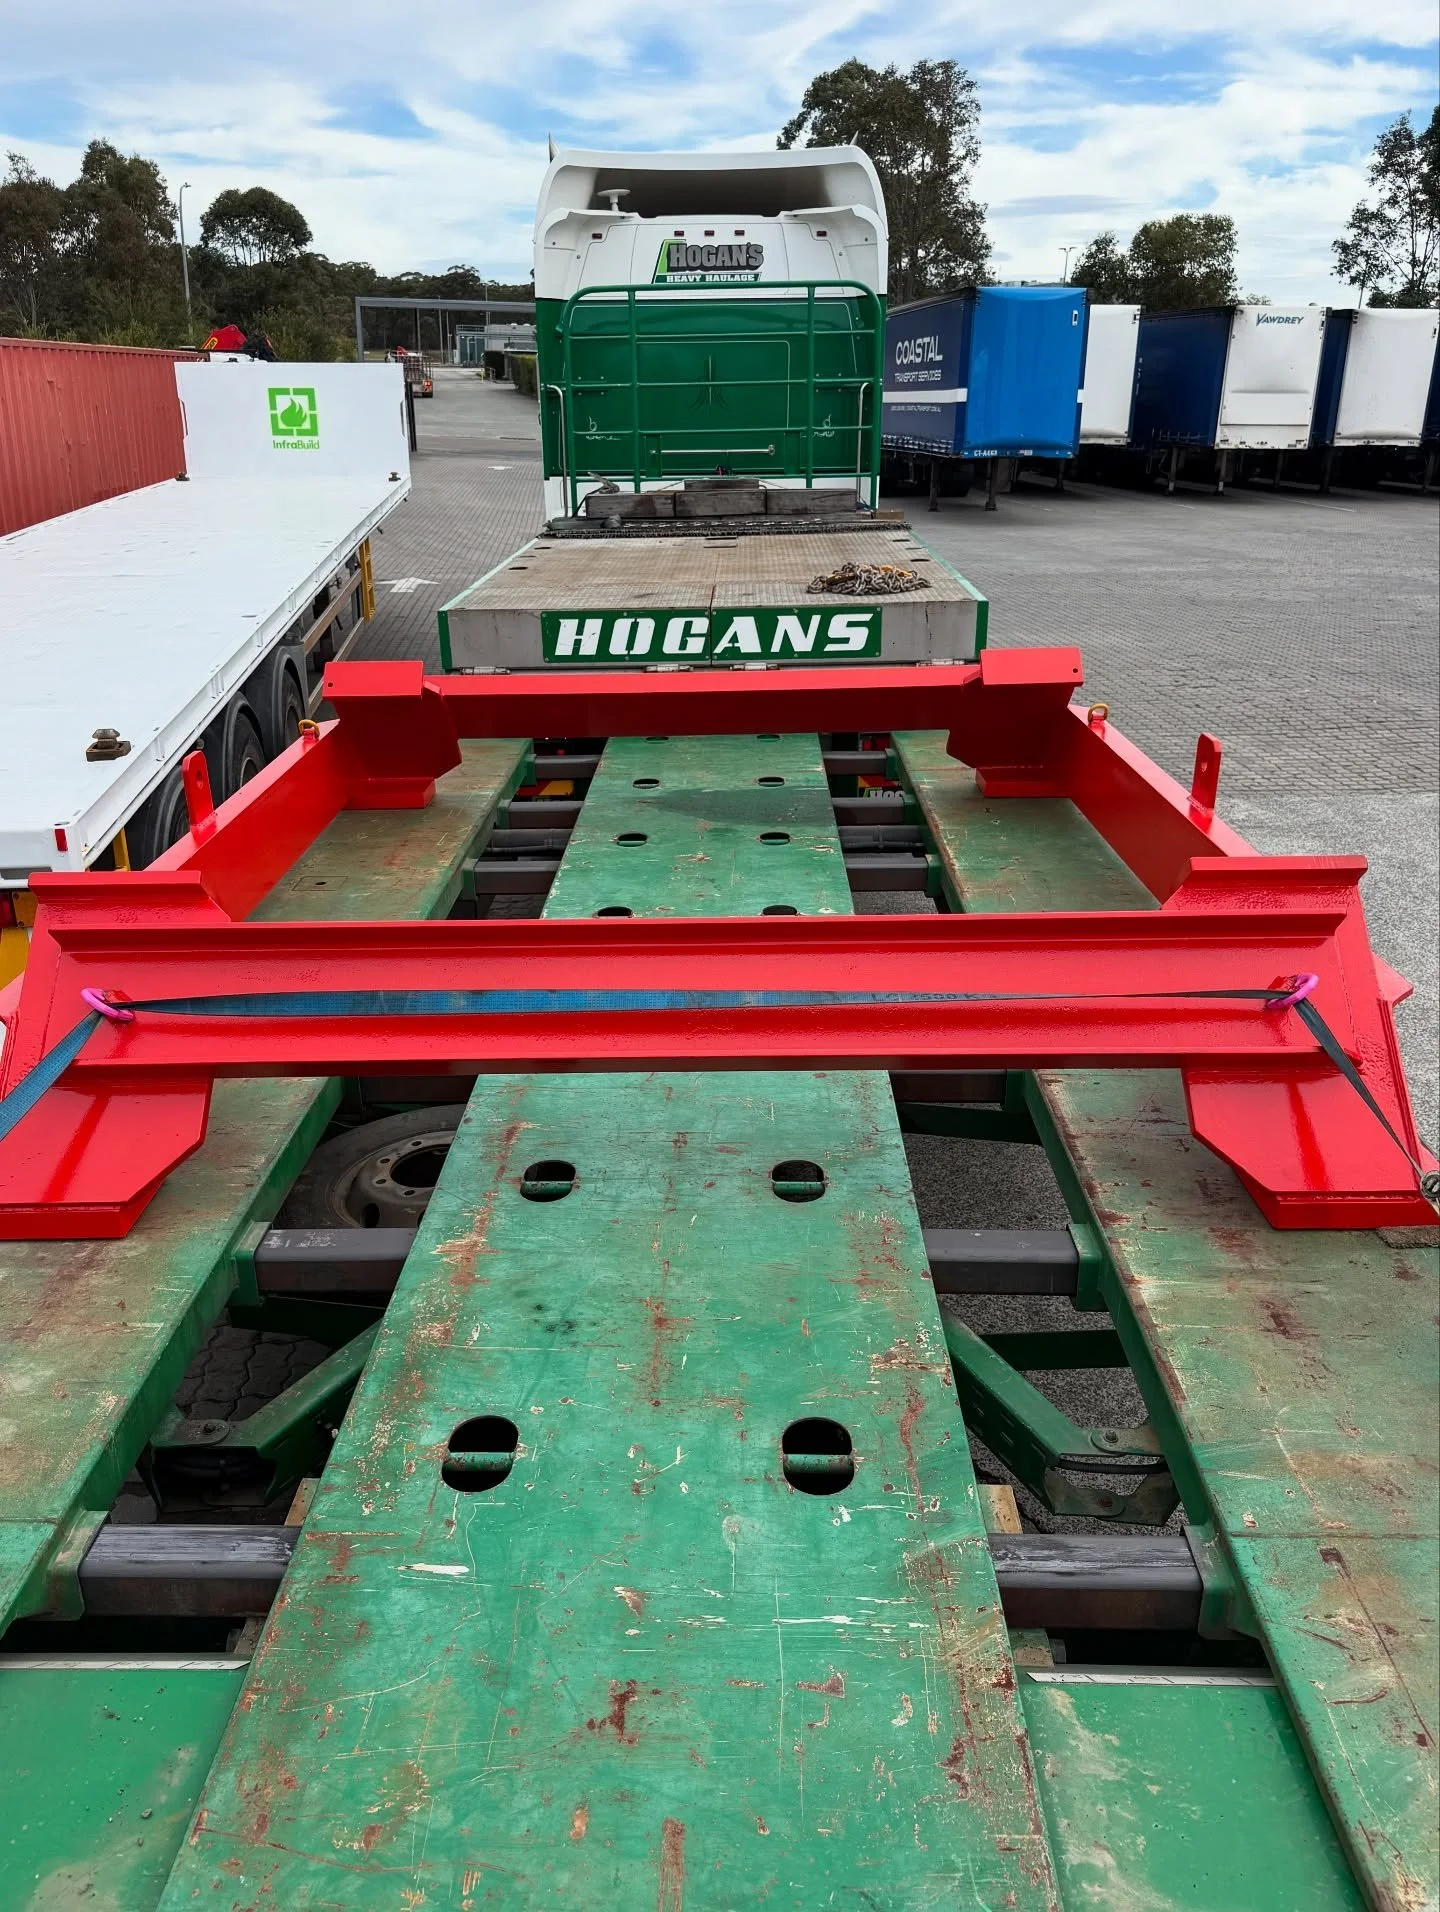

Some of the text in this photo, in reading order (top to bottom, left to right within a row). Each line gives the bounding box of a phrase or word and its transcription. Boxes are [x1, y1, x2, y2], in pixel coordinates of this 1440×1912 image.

[669, 242, 764, 270] HOGAN'S
[666, 274, 755, 283] HEAVY HAULAGE
[895, 335, 943, 366] COASTAL
[894, 369, 942, 383] TRANSPORT SERVICES
[272, 439, 320, 450] InfraBuild
[554, 613, 874, 656] HOGANS
